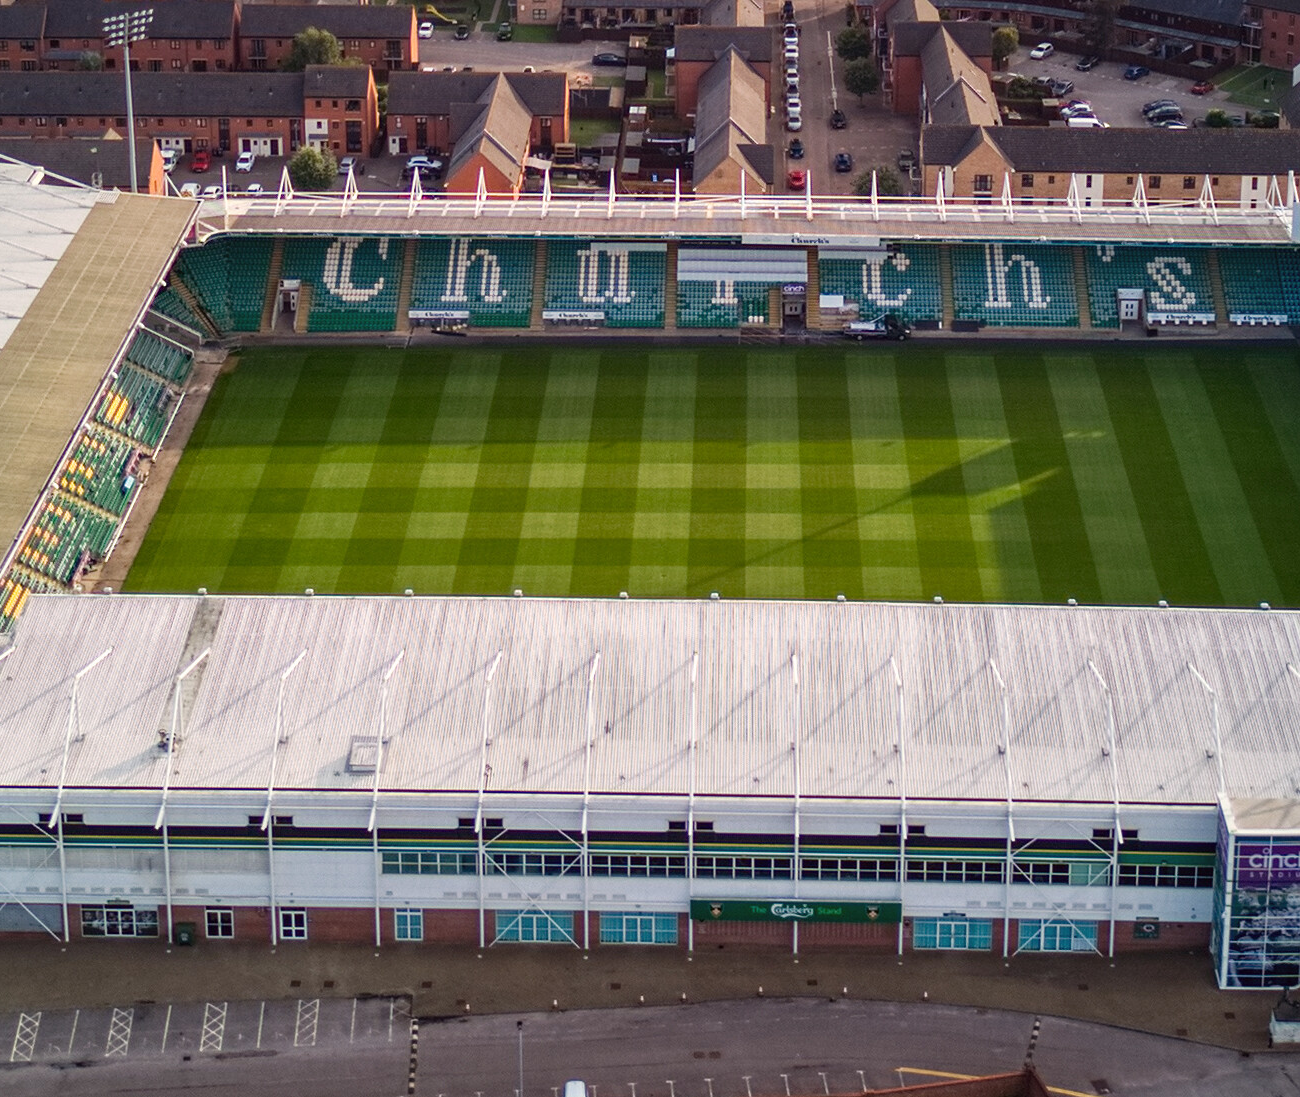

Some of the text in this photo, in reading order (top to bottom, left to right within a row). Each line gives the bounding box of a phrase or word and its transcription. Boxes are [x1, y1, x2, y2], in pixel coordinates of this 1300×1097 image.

[751, 903, 842, 917] The Carlsberg Stand
